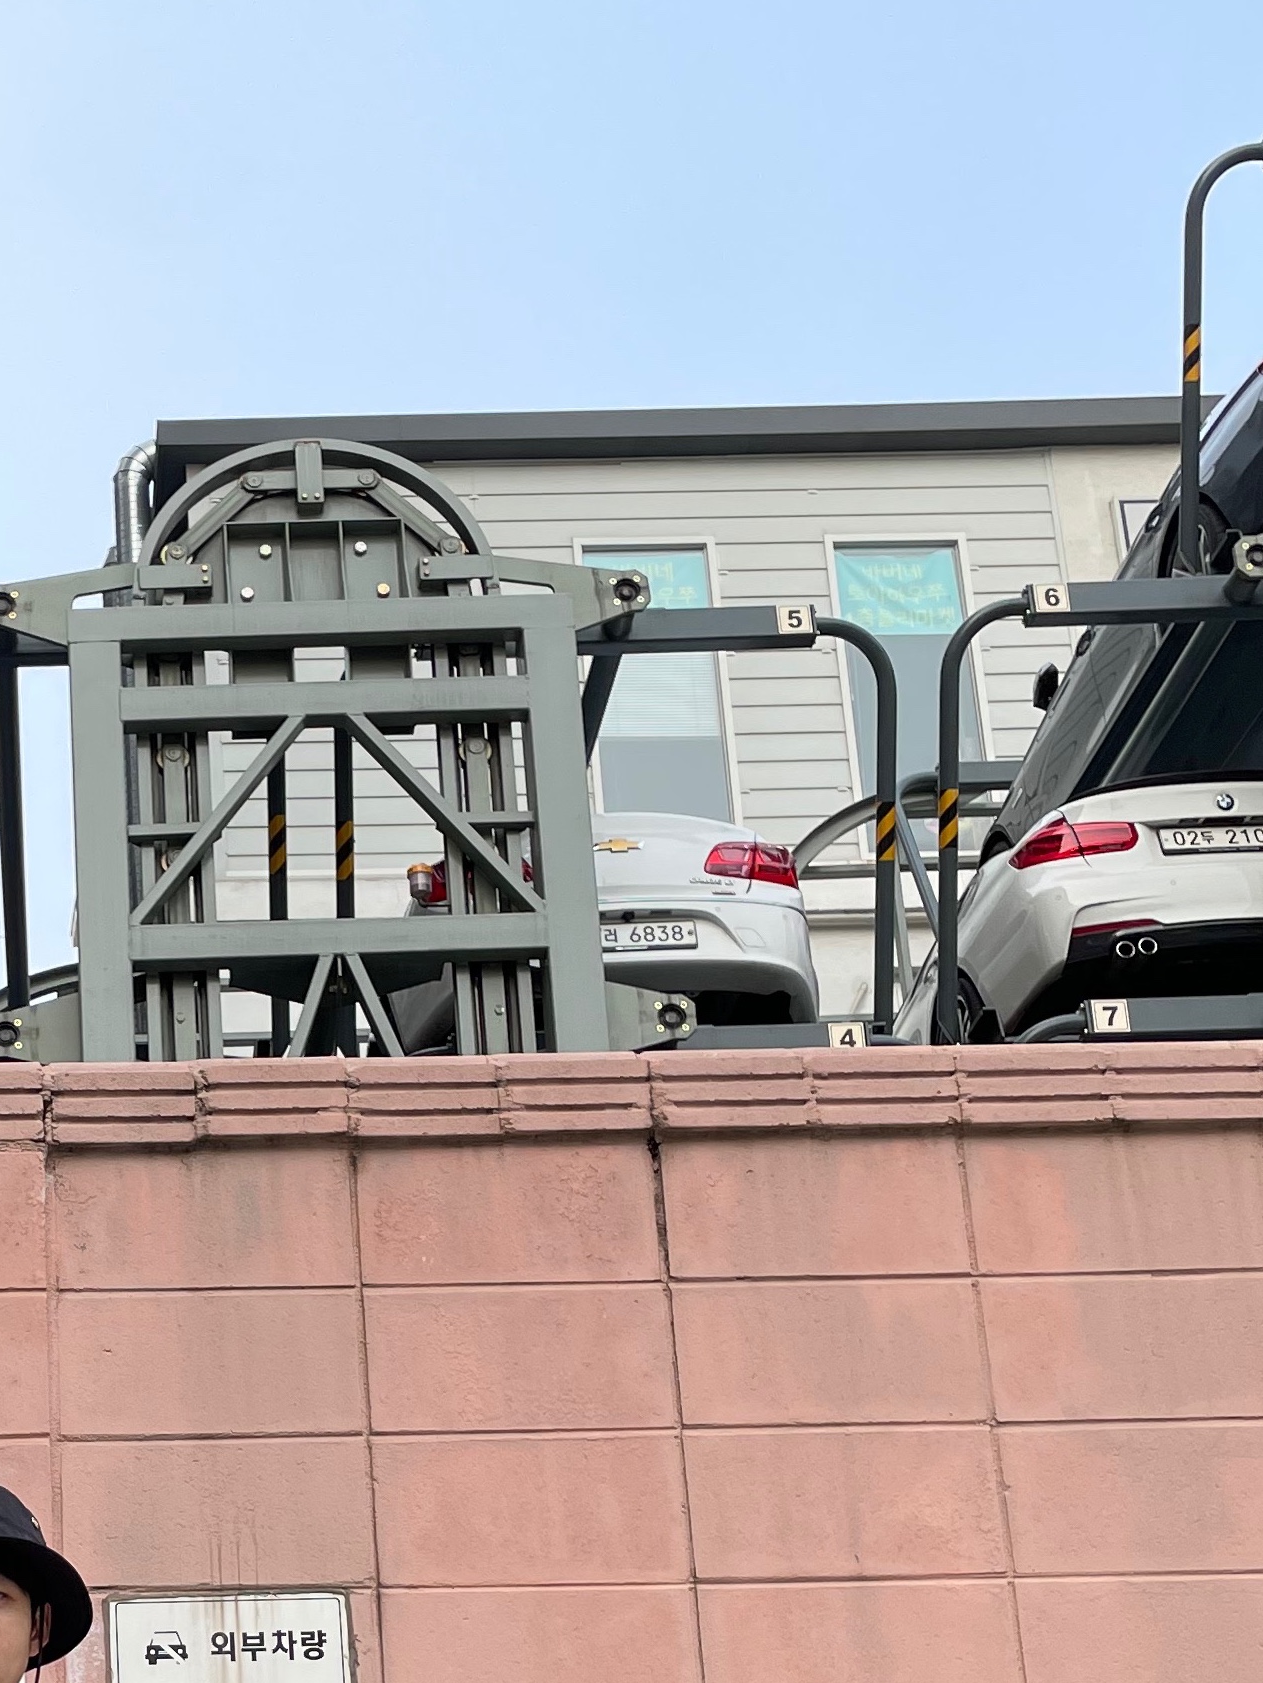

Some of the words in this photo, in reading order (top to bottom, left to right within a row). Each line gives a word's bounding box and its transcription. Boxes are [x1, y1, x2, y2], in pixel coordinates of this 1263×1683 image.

[1045, 588, 1060, 607] 6
[788, 610, 803, 629] 5
[1173, 830, 1215, 847] 02두
[602, 927, 618, 944] 러
[630, 925, 684, 944] 6838
[1102, 1006, 1118, 1026] 7
[840, 1028, 856, 1047] 4
[210, 1629, 328, 1662] 외부차량
